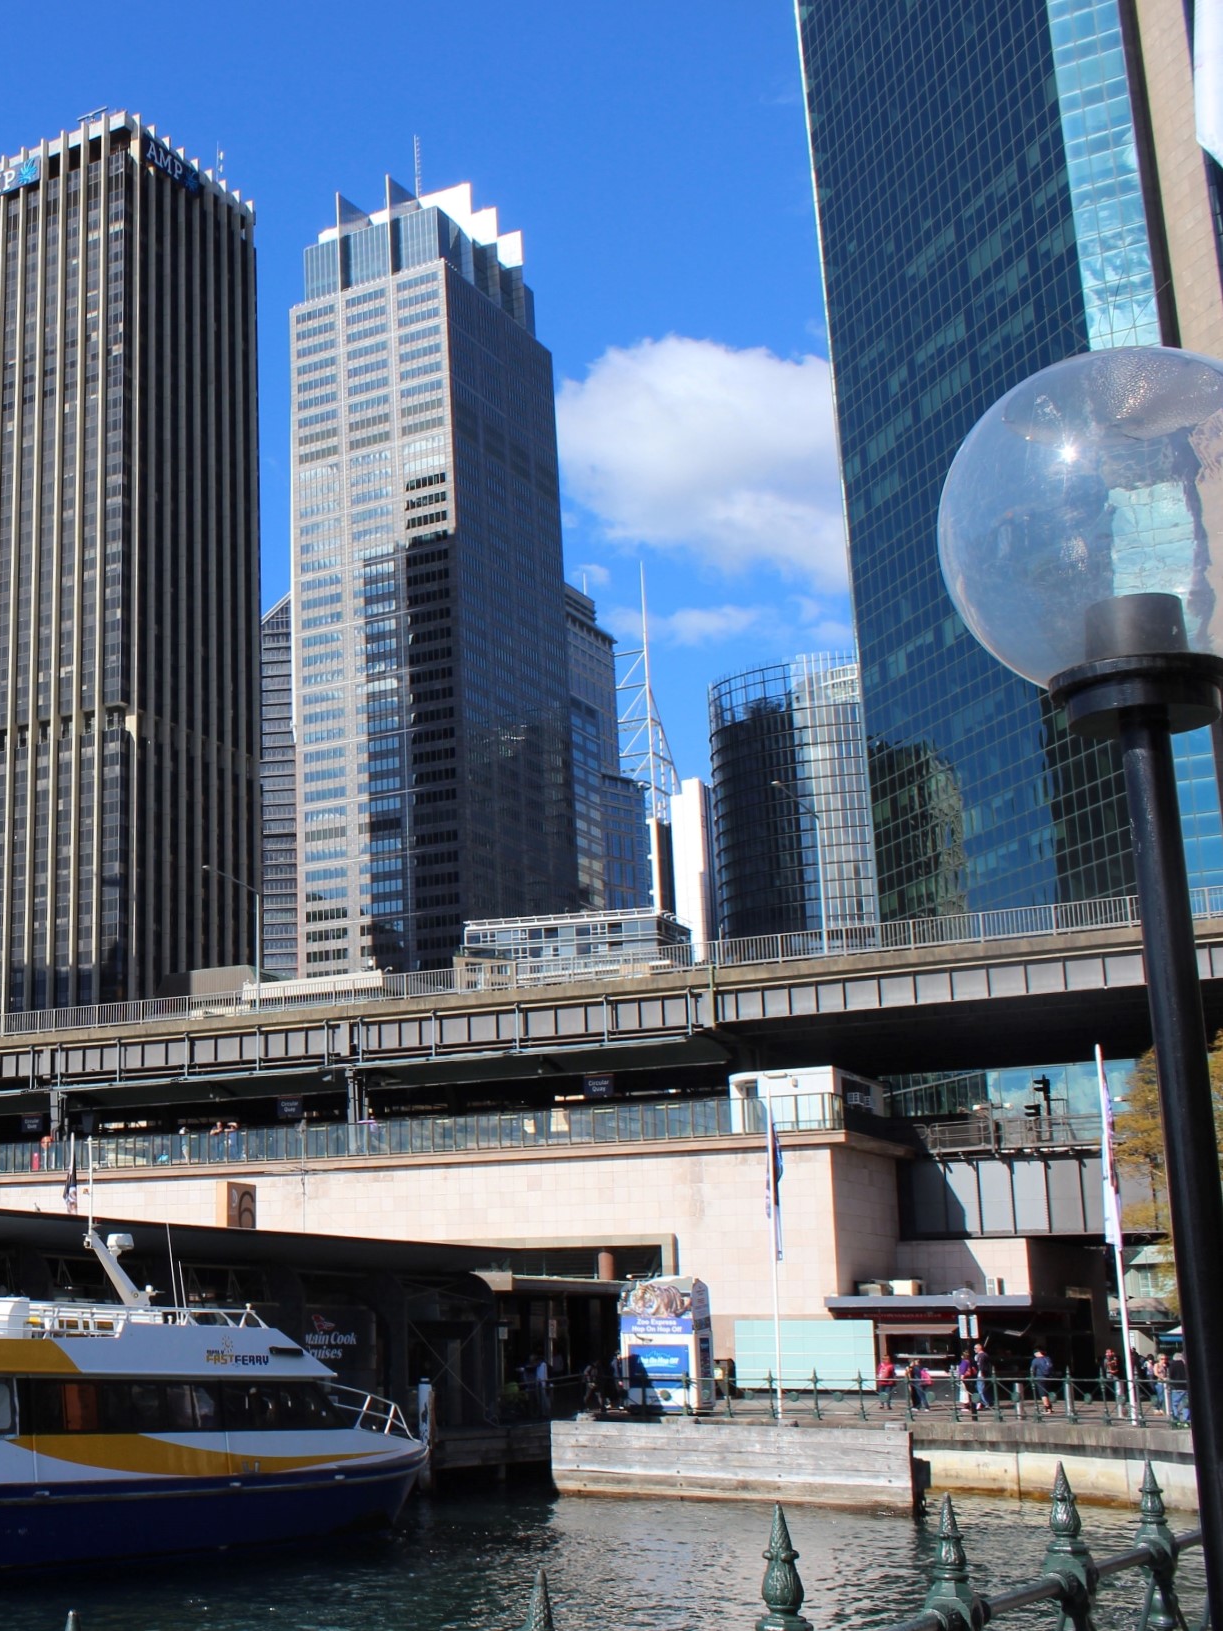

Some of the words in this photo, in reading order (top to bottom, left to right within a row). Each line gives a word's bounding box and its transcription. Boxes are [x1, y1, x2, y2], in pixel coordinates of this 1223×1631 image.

[146, 140, 183, 180] AMP
[238, 1190, 256, 1228] 6
[651, 1318, 677, 1327] Express
[305, 1331, 330, 1345] tain
[330, 1331, 358, 1345] Cook
